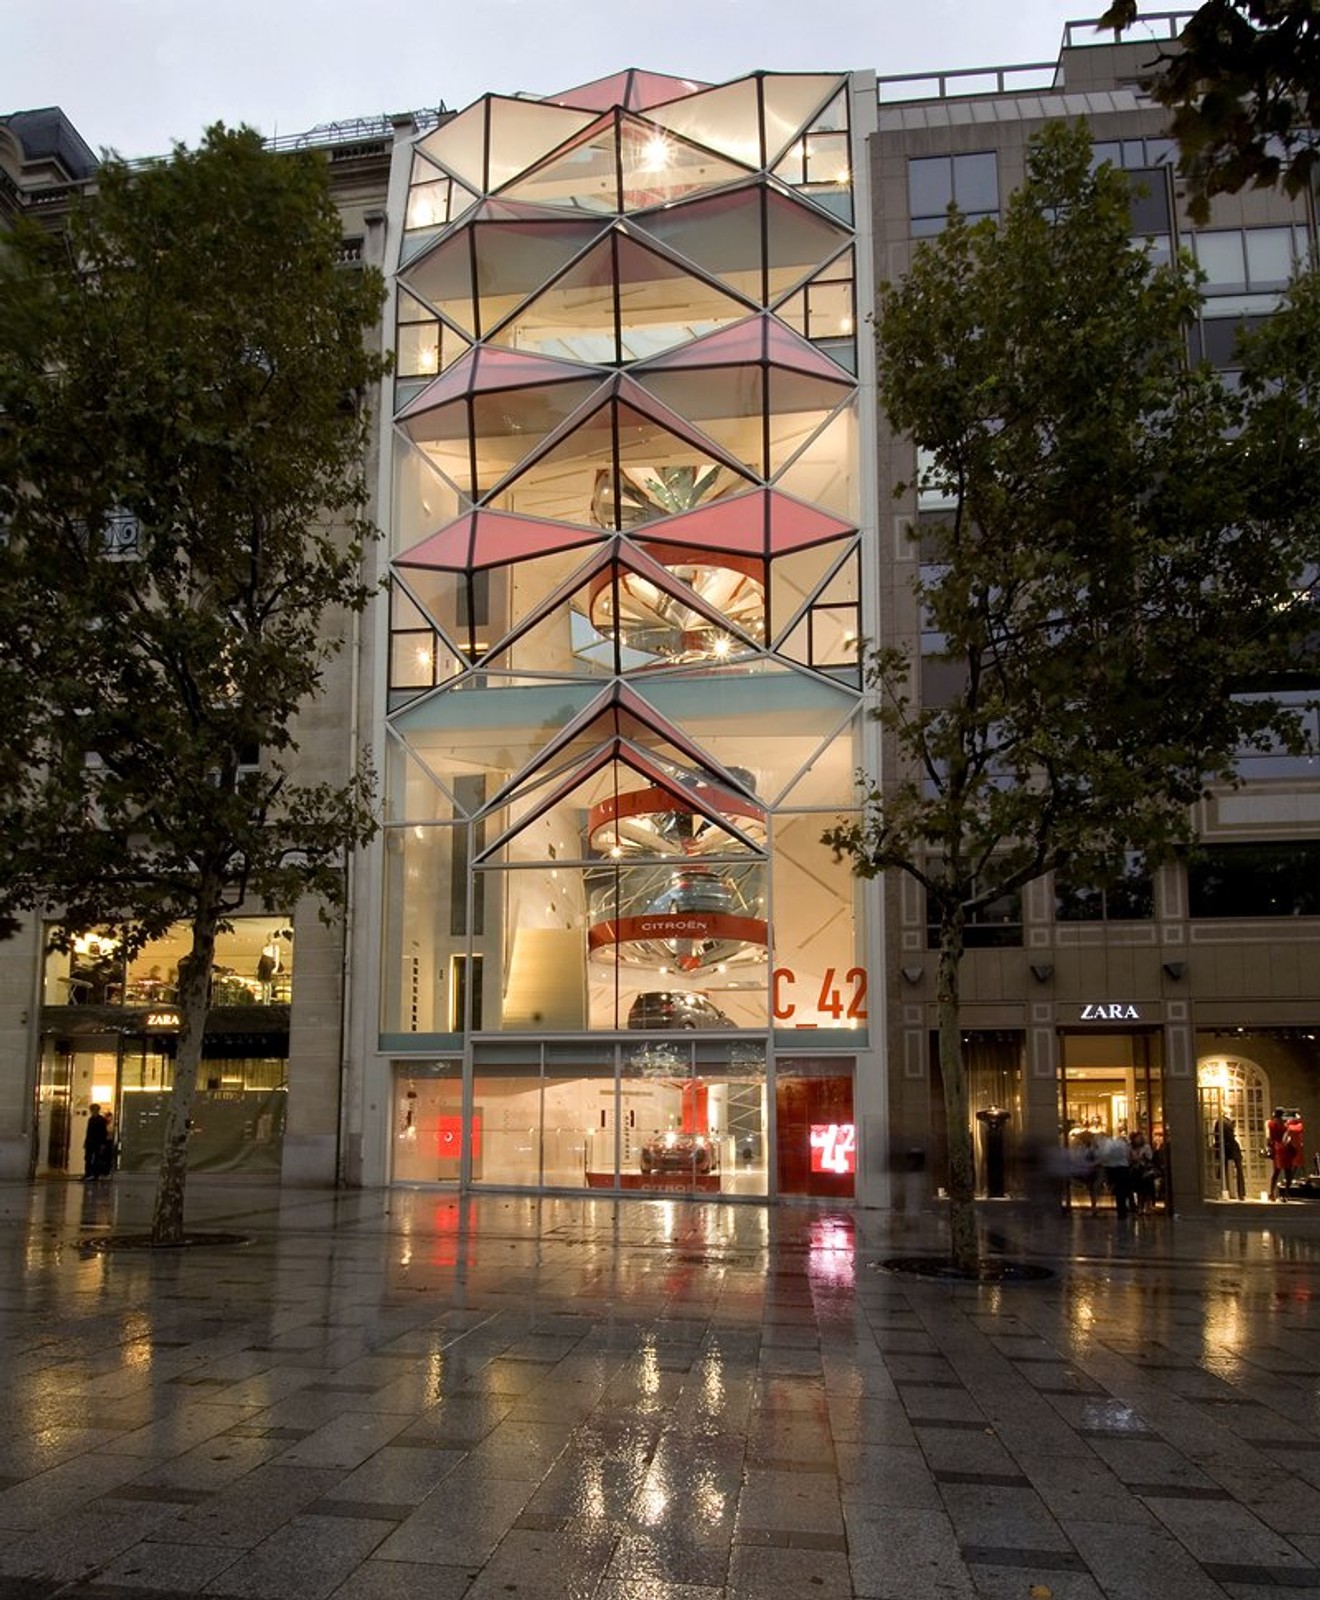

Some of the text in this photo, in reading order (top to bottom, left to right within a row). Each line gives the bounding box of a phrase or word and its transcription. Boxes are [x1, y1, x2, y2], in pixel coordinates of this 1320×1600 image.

[641, 920, 707, 931] CITROËN
[773, 967, 868, 1031] C_42
[1080, 1003, 1139, 1019] ZARA
[147, 1014, 180, 1025] ZARA
